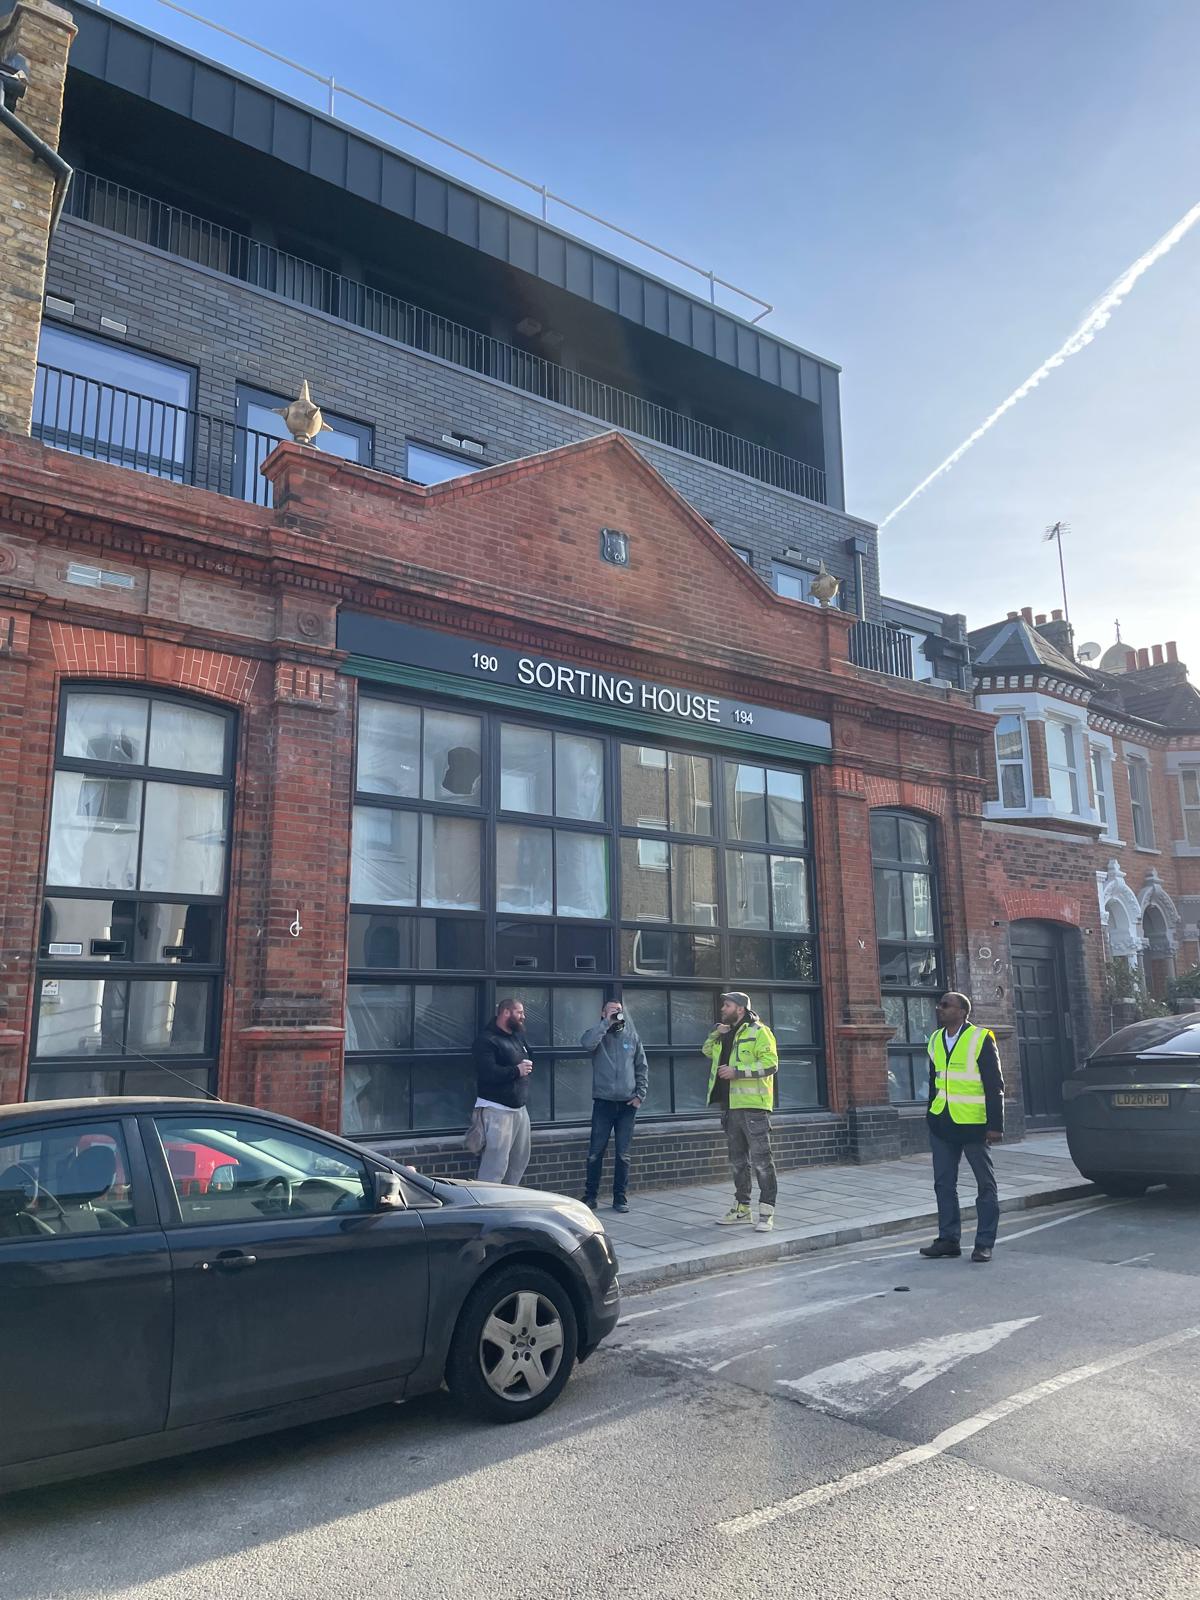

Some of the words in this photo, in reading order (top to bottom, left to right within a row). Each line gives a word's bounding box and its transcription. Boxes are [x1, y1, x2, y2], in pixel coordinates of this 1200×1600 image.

[472, 653, 498, 672] 190
[517, 658, 634, 704] SORTING
[641, 684, 721, 723] HOUSE
[734, 709, 754, 725] 194
[1117, 1094, 1144, 1105] LD20
